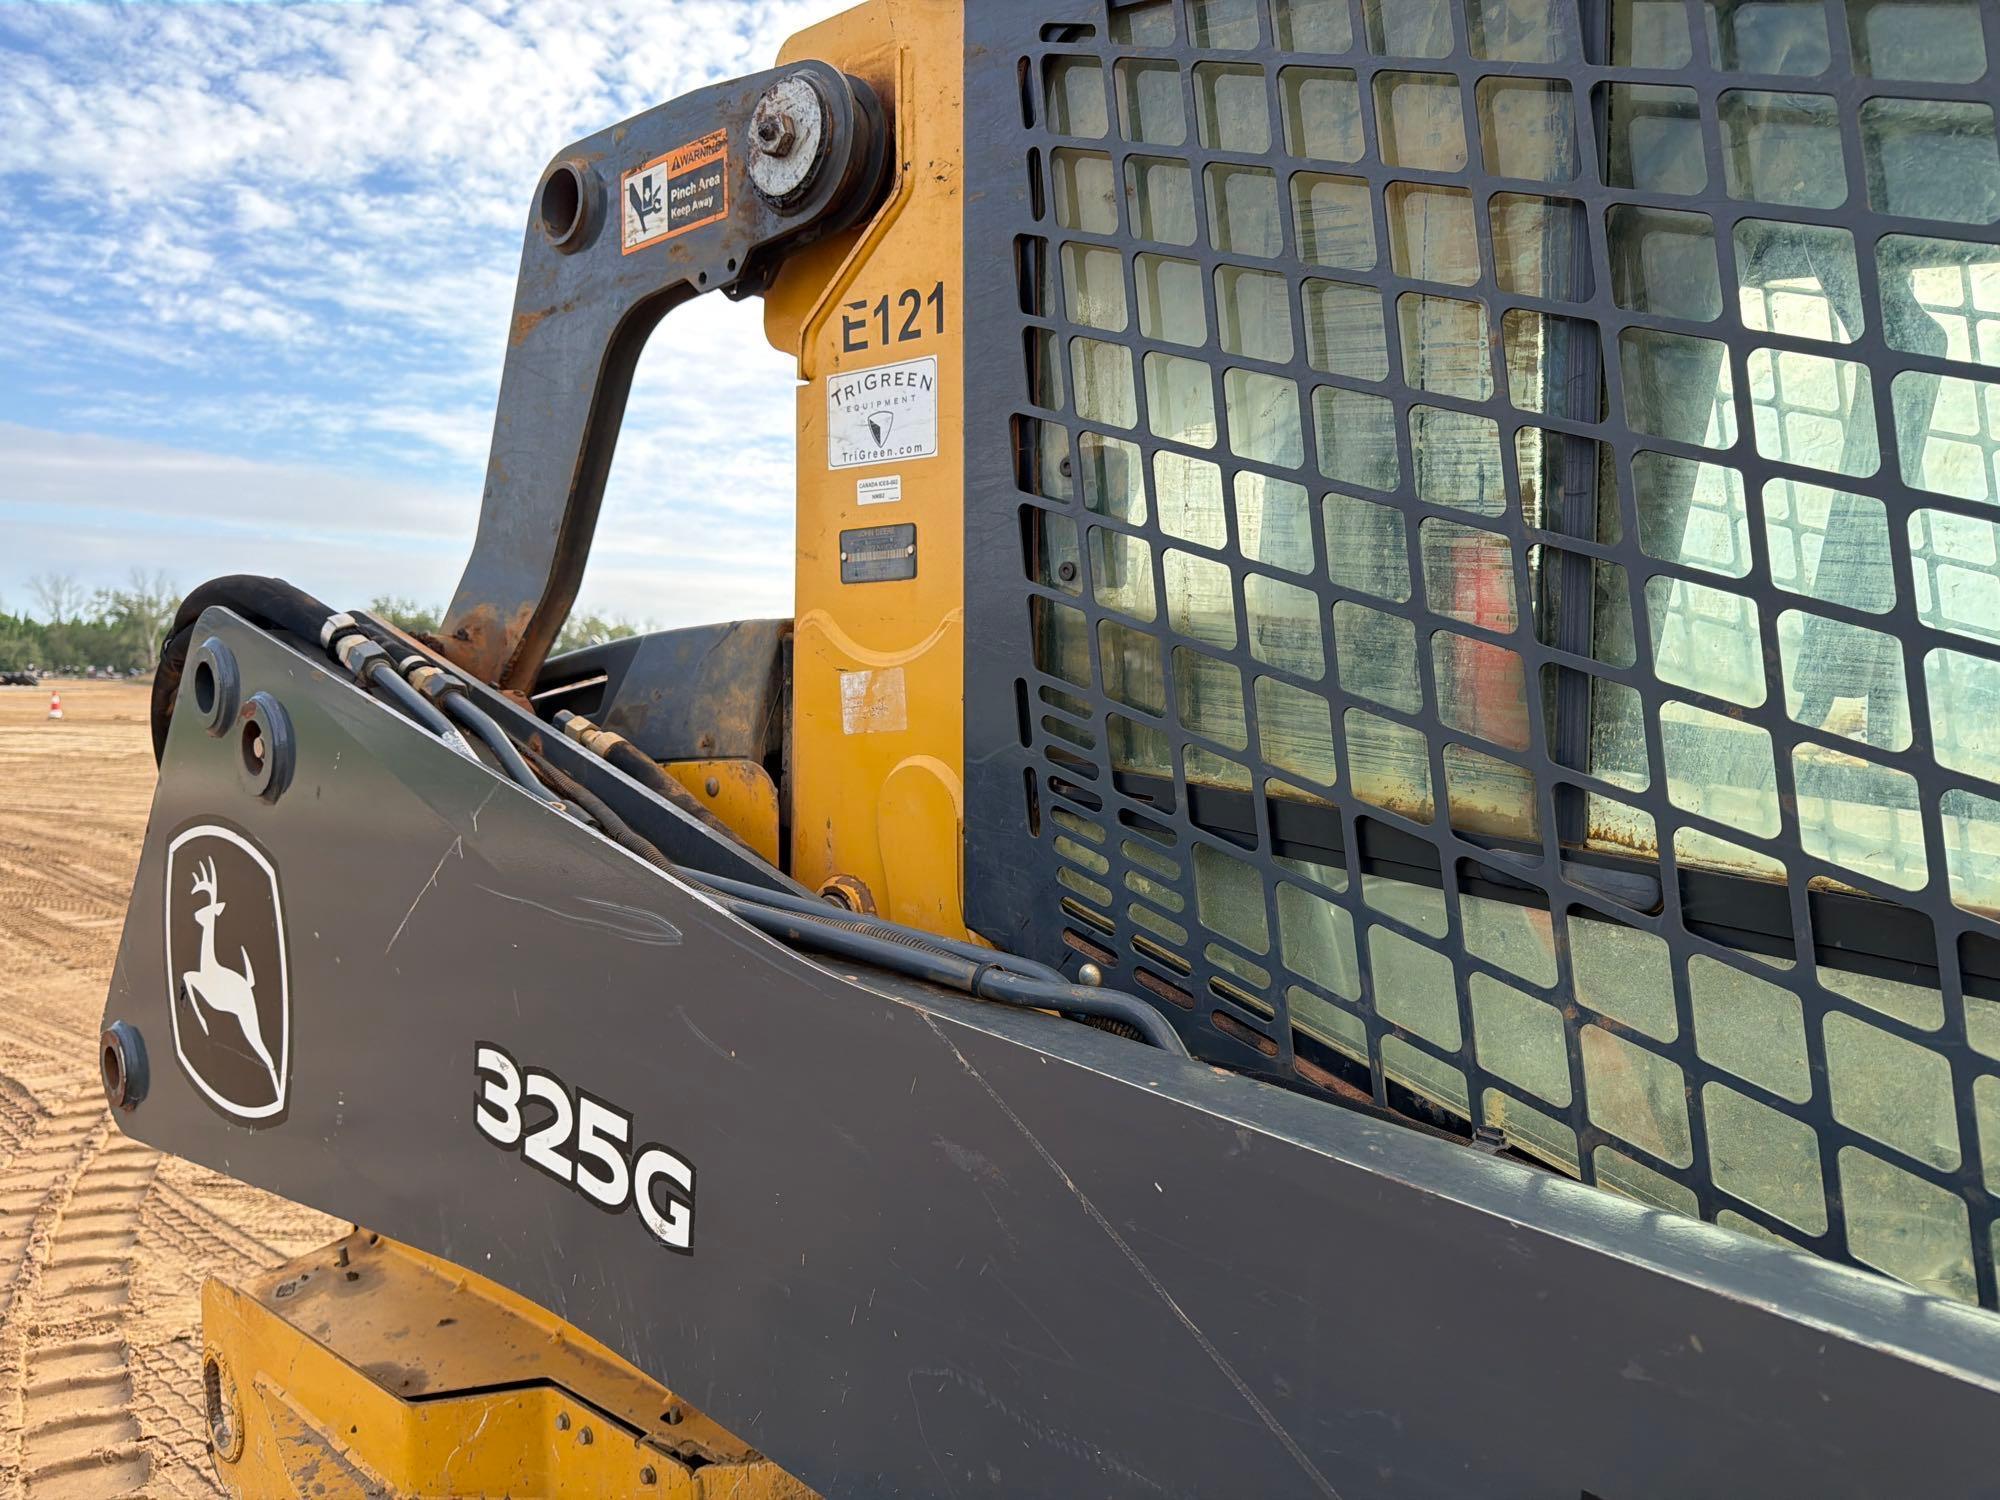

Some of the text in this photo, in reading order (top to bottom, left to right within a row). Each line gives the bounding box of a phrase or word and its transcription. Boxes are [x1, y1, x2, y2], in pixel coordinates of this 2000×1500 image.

[681, 141, 722, 167] WARNING
[670, 174, 720, 202] Pinch Area
[671, 195, 714, 219] Keep Away
[842, 280, 944, 353] E121
[831, 372, 933, 406] TRIGREEN
[846, 394, 916, 413] EQUIPMENT
[842, 443, 923, 463] TriGreen.com
[858, 481, 878, 489] CANADA
[476, 1047, 693, 1248] 325G
